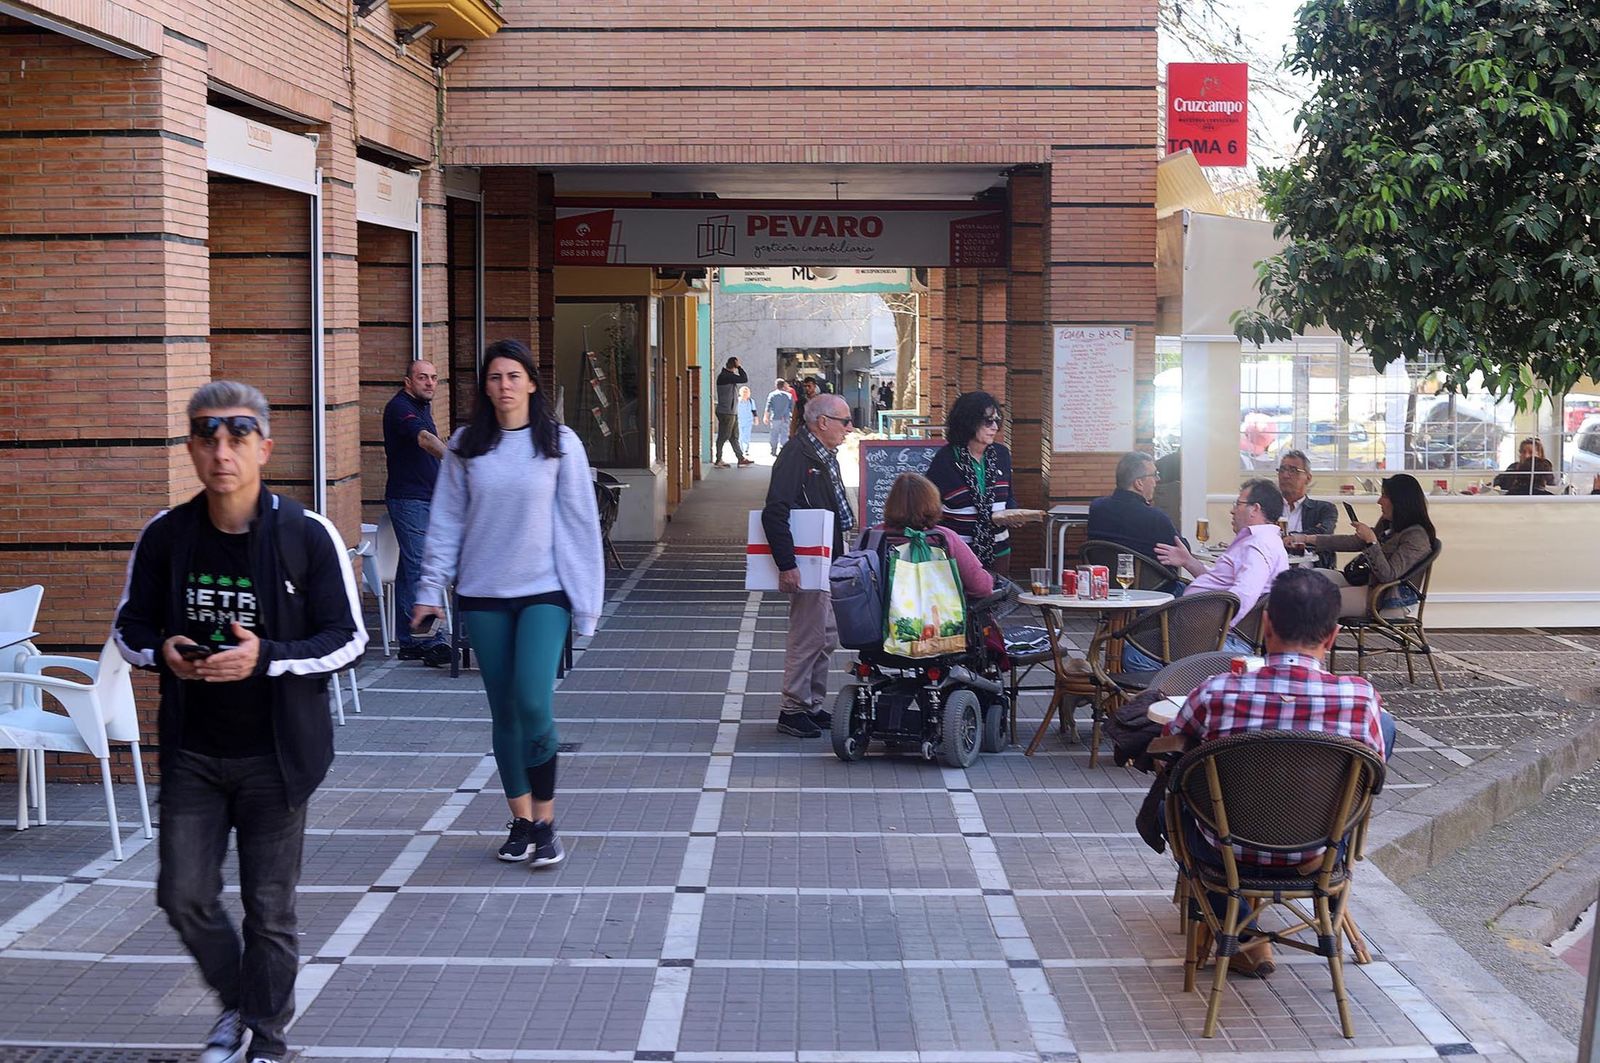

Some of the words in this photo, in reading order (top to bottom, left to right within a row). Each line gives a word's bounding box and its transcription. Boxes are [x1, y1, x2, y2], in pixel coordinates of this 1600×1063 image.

[1174, 97, 1243, 115] Cruzcampo
[1168, 139, 1222, 154] TOMA
[1228, 140, 1238, 154] 6
[747, 215, 884, 238] PEVARO
[897, 448, 911, 462] 6
